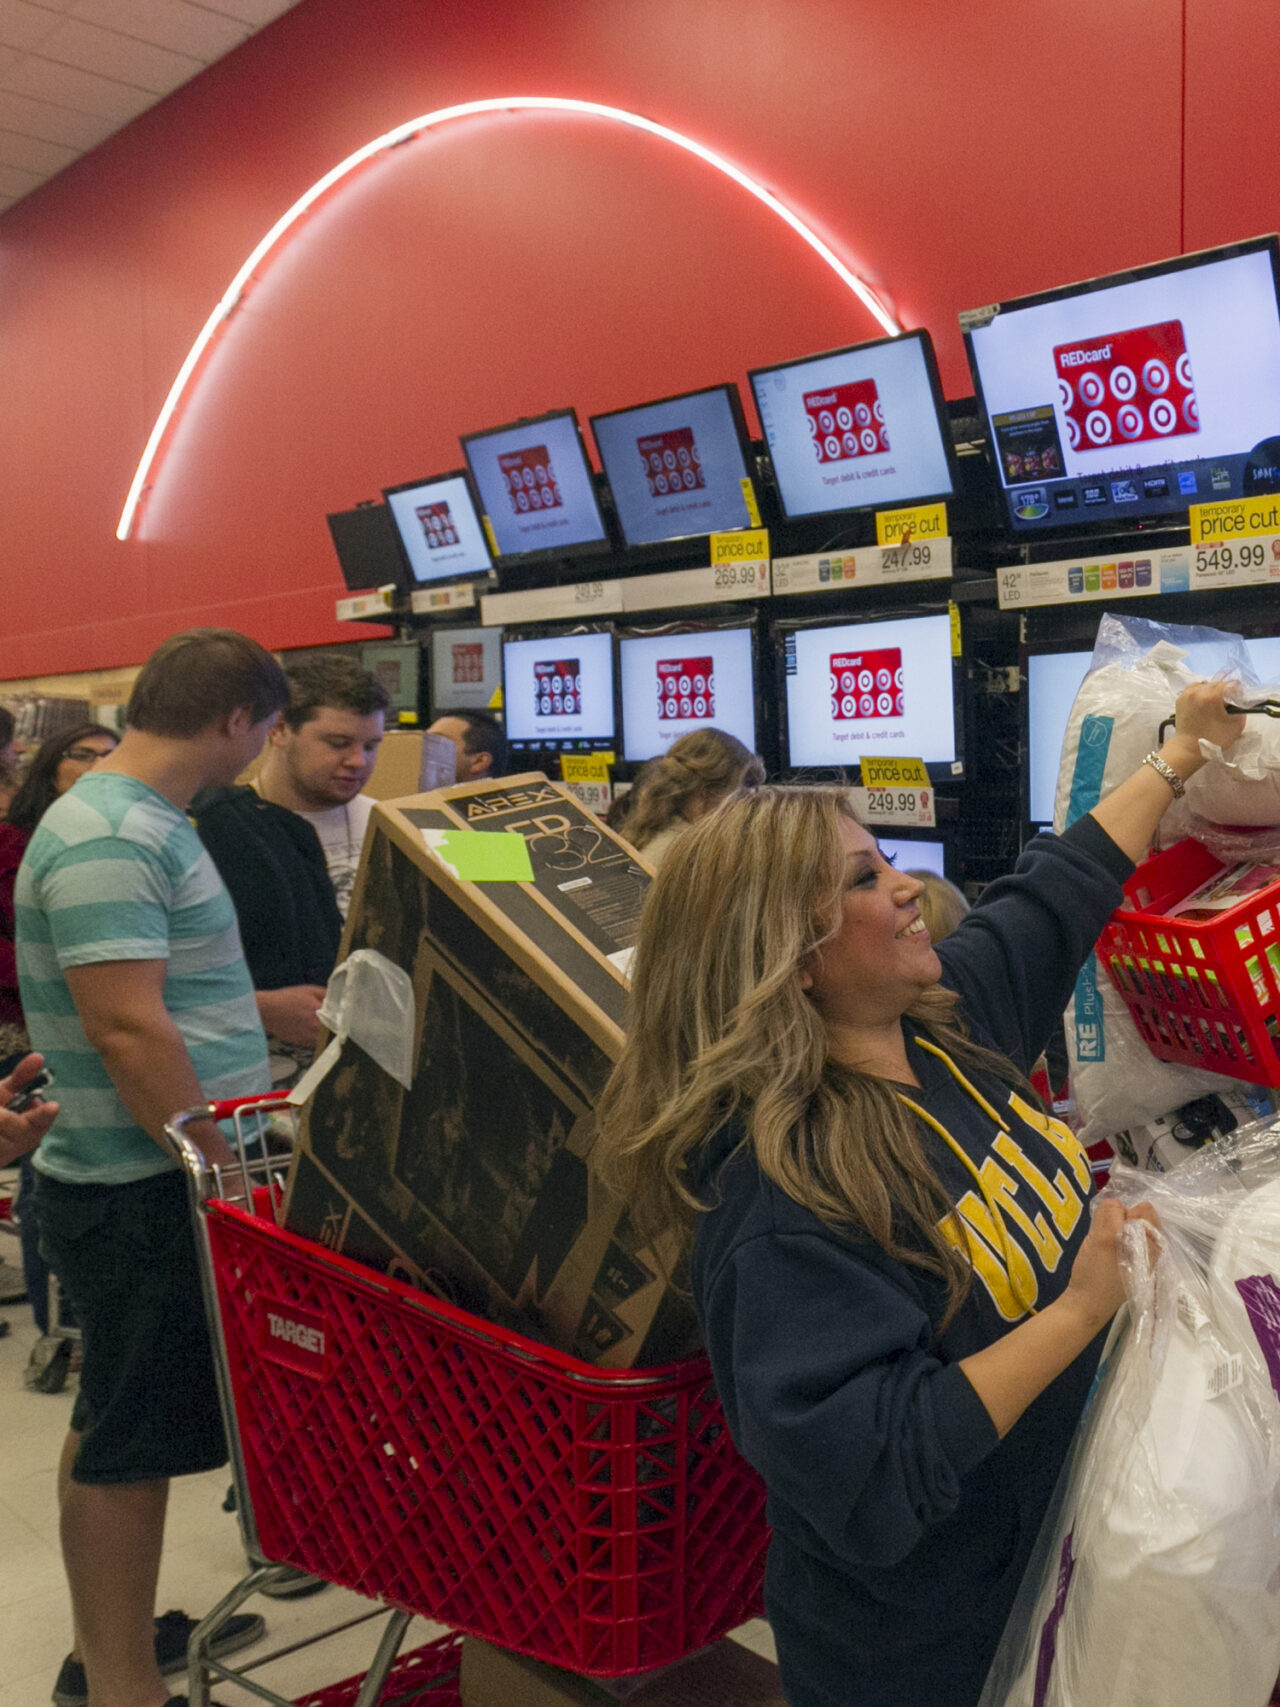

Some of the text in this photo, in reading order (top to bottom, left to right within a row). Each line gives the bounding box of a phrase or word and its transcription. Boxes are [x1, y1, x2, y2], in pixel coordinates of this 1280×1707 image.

[884, 516, 941, 540] price cut
[1200, 508, 1280, 540] price cut
[881, 545, 932, 569] 247.99
[1196, 545, 1265, 573] 549.99
[714, 566, 756, 585] 269.99
[1003, 590, 1021, 601] LED
[868, 765, 924, 784] price cut
[868, 793, 916, 811] 249.99
[1079, 1023, 1097, 1057] RE
[267, 1313, 325, 1355] TARGET
